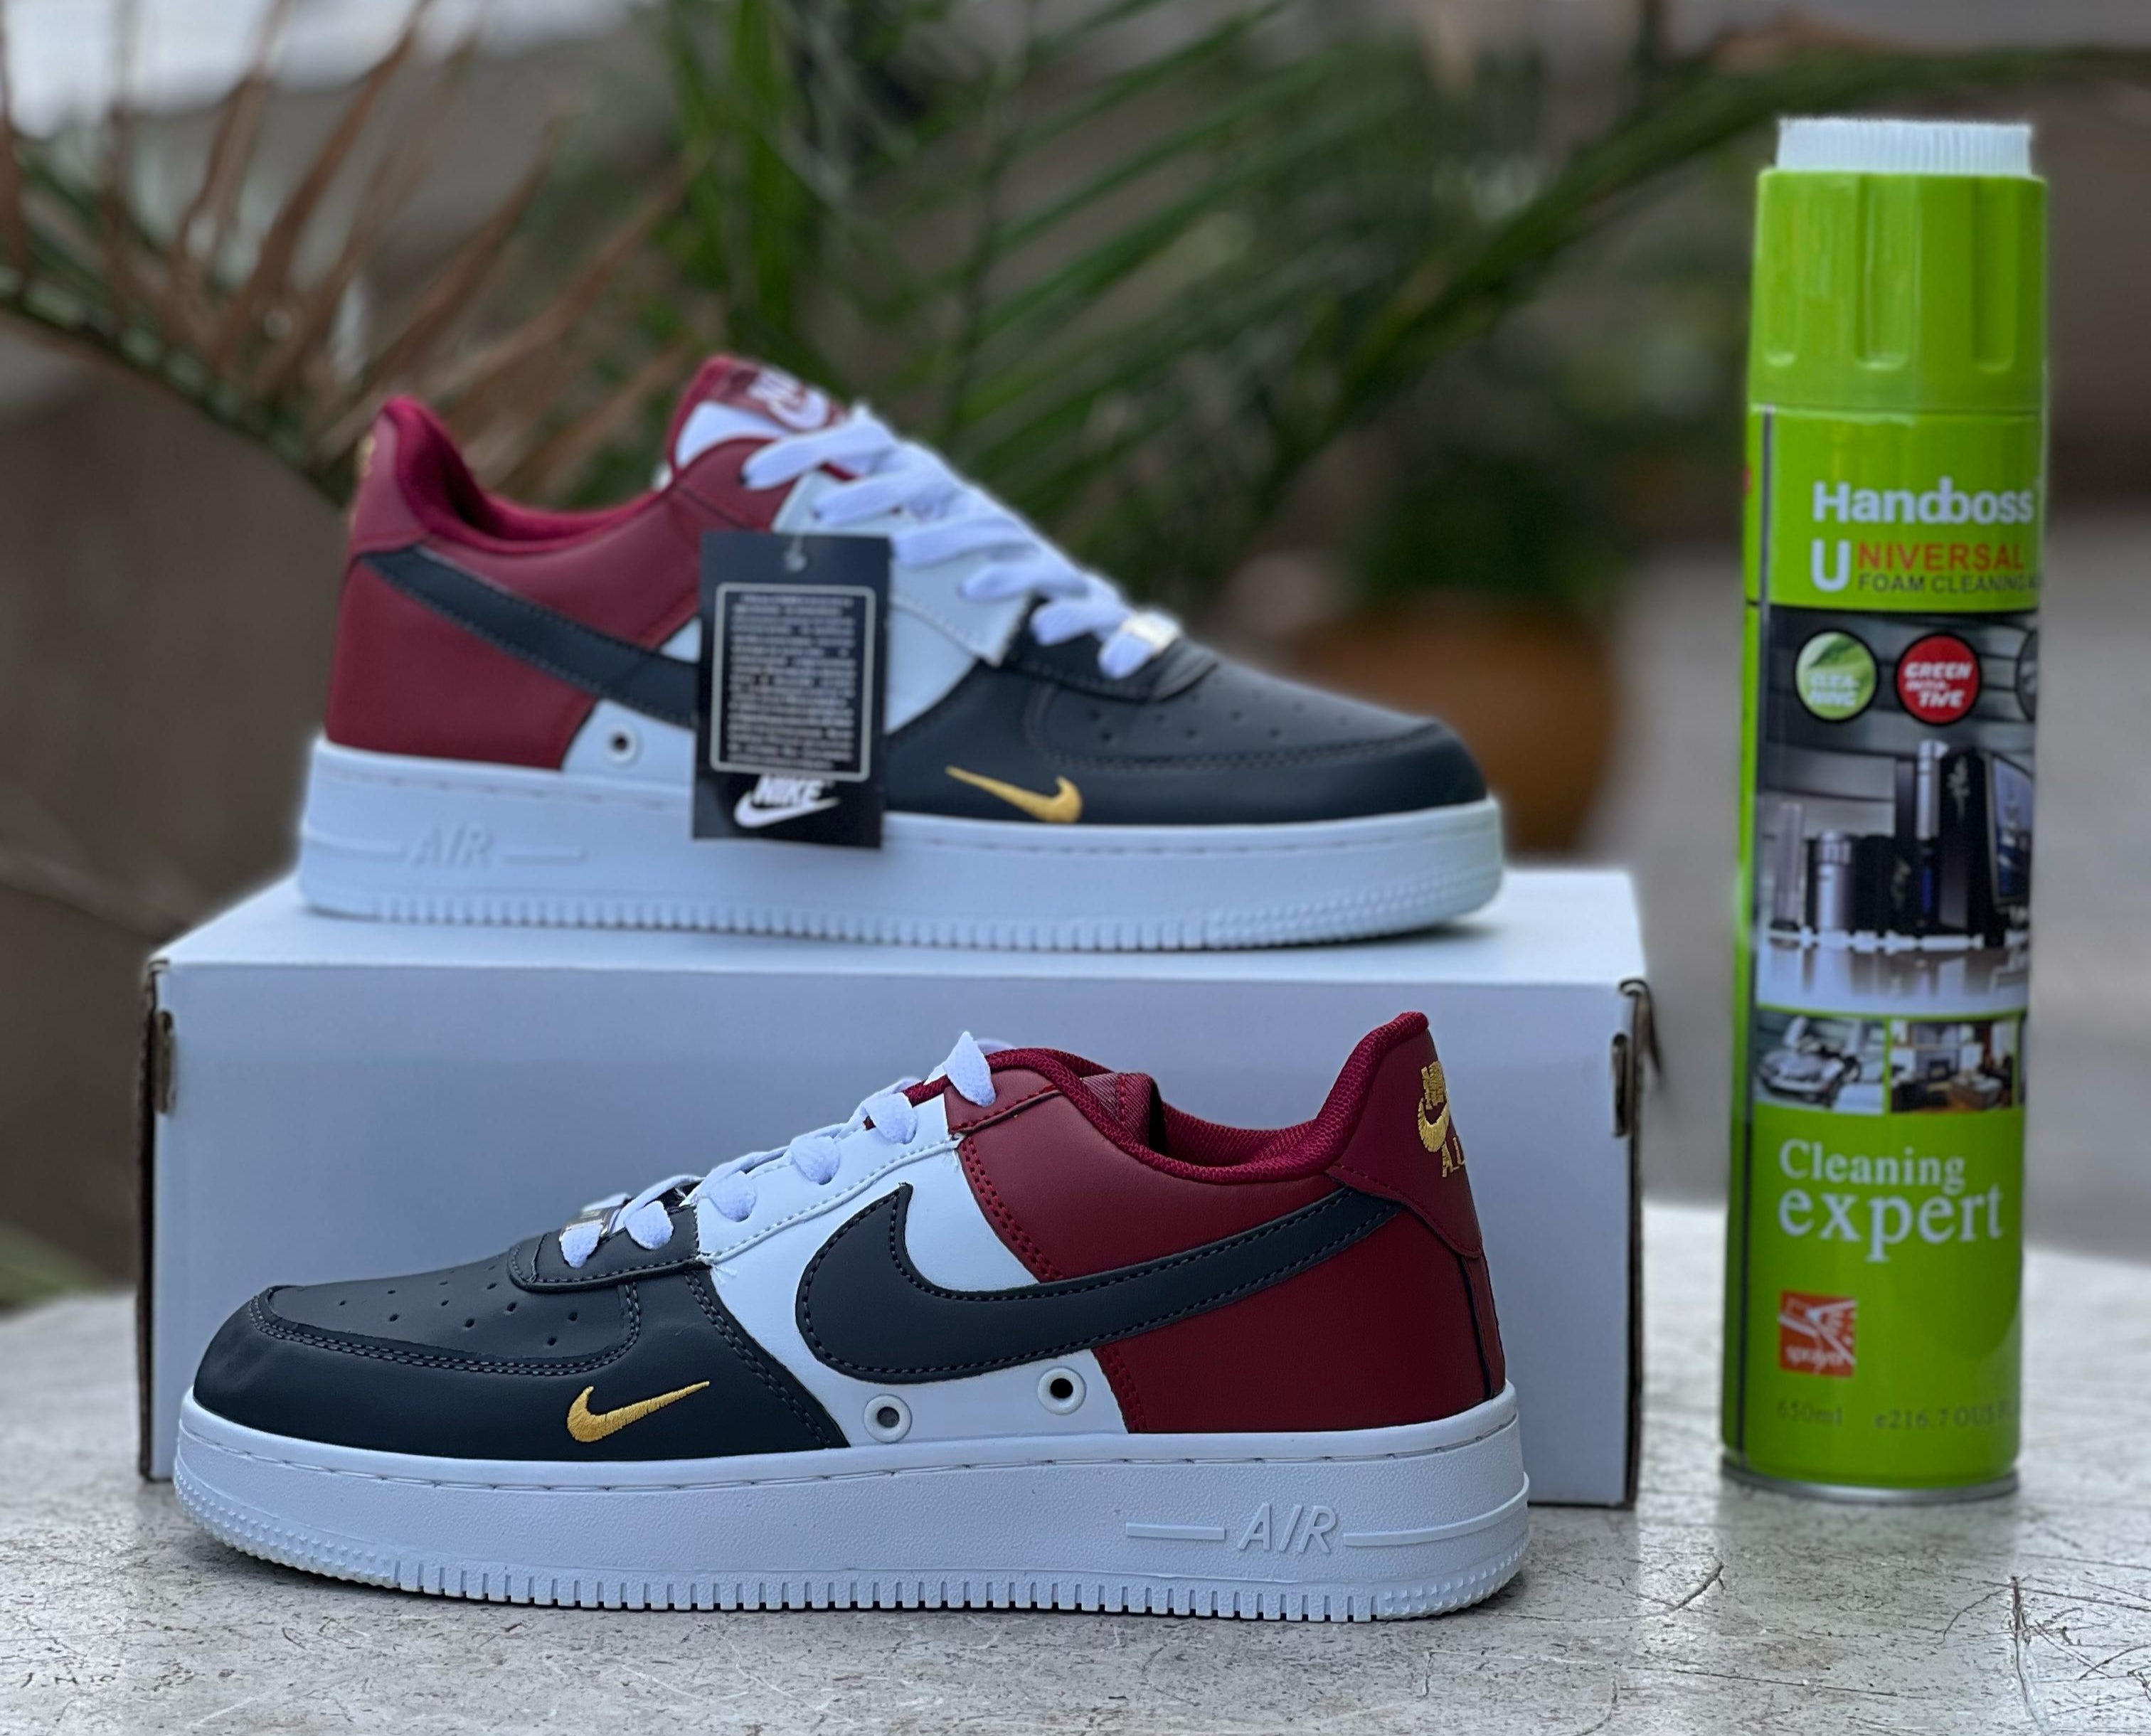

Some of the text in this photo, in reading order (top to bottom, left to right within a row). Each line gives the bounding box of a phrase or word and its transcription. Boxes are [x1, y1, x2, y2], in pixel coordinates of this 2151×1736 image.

[1812, 476, 2034, 524] Handboss
[1857, 573, 1925, 593] FOAM
[1904, 661, 1972, 679] GREEN
[753, 774, 824, 806] NIKE
[411, 821, 495, 869] AIR
[1779, 1138, 1967, 1195] Cleaning
[1778, 1183, 2003, 1263] expert
[1238, 1503, 1338, 1553] AIR
